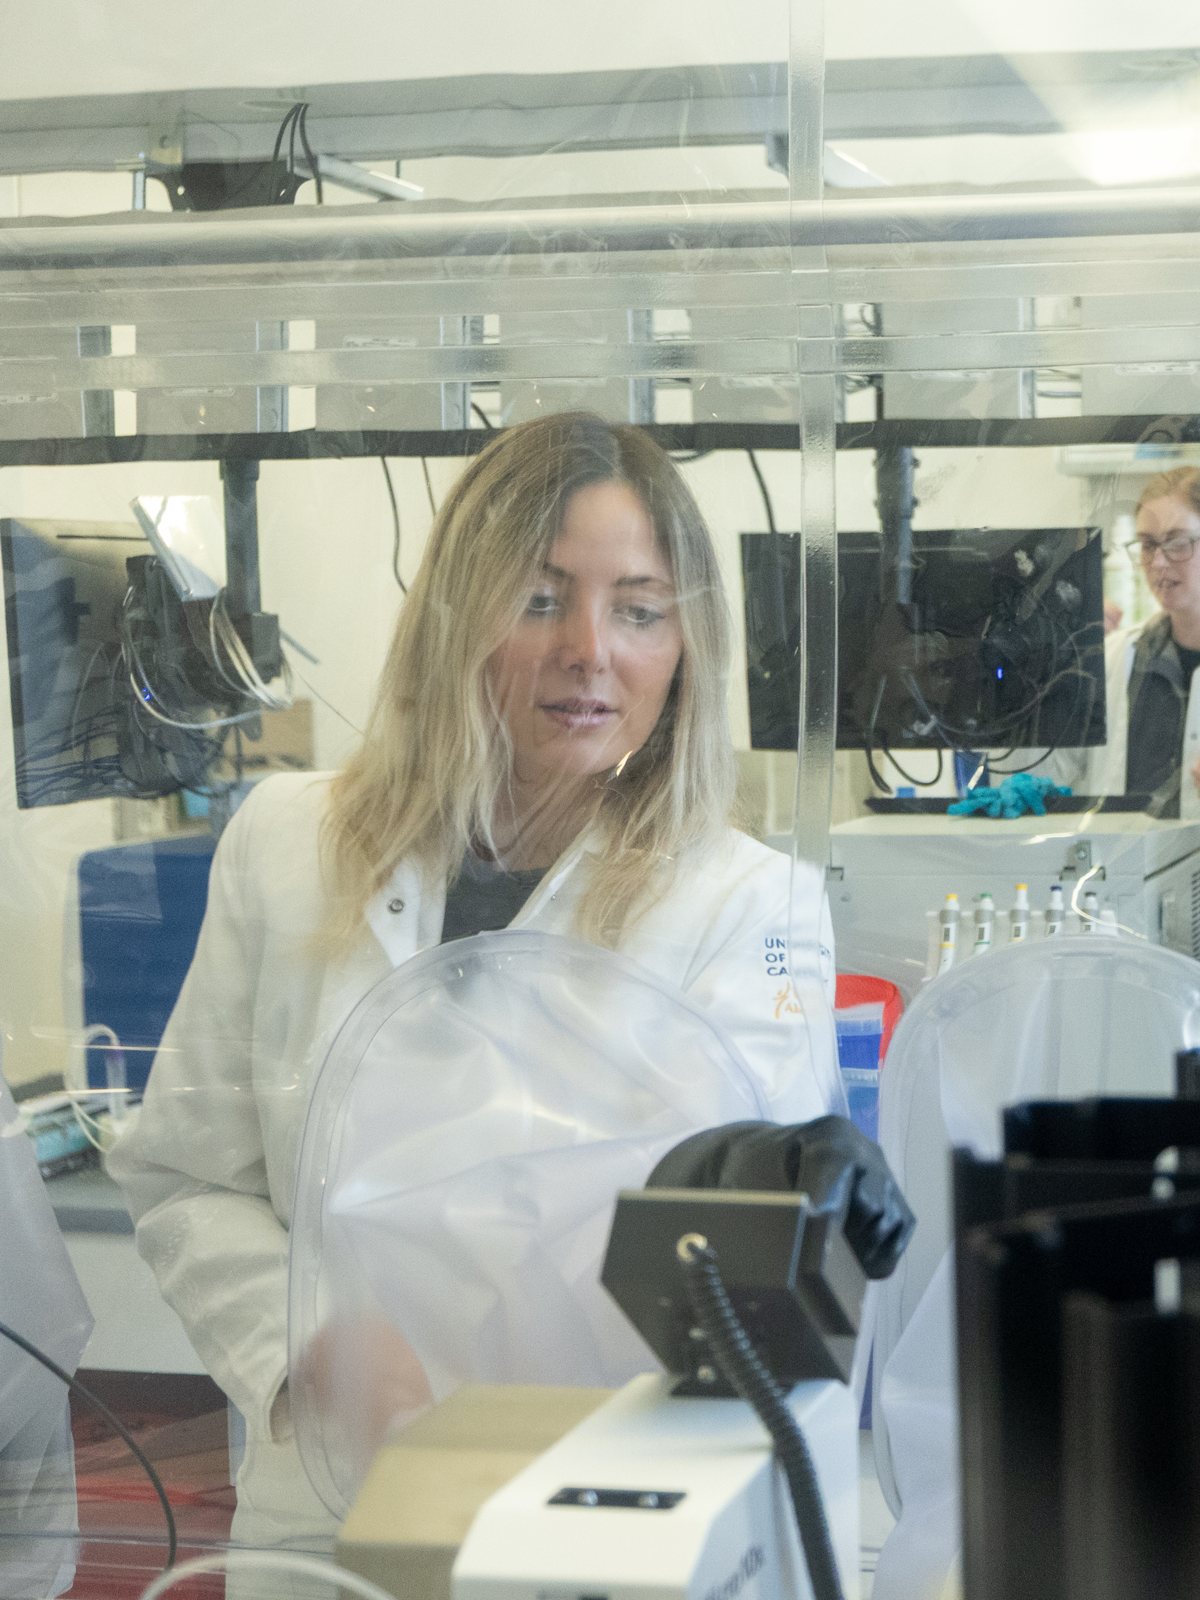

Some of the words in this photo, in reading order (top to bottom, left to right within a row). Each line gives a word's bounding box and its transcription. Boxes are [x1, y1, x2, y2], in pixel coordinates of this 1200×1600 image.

[764, 937, 786, 949] UN
[765, 953, 786, 963] OF
[766, 966, 788, 976] CA
